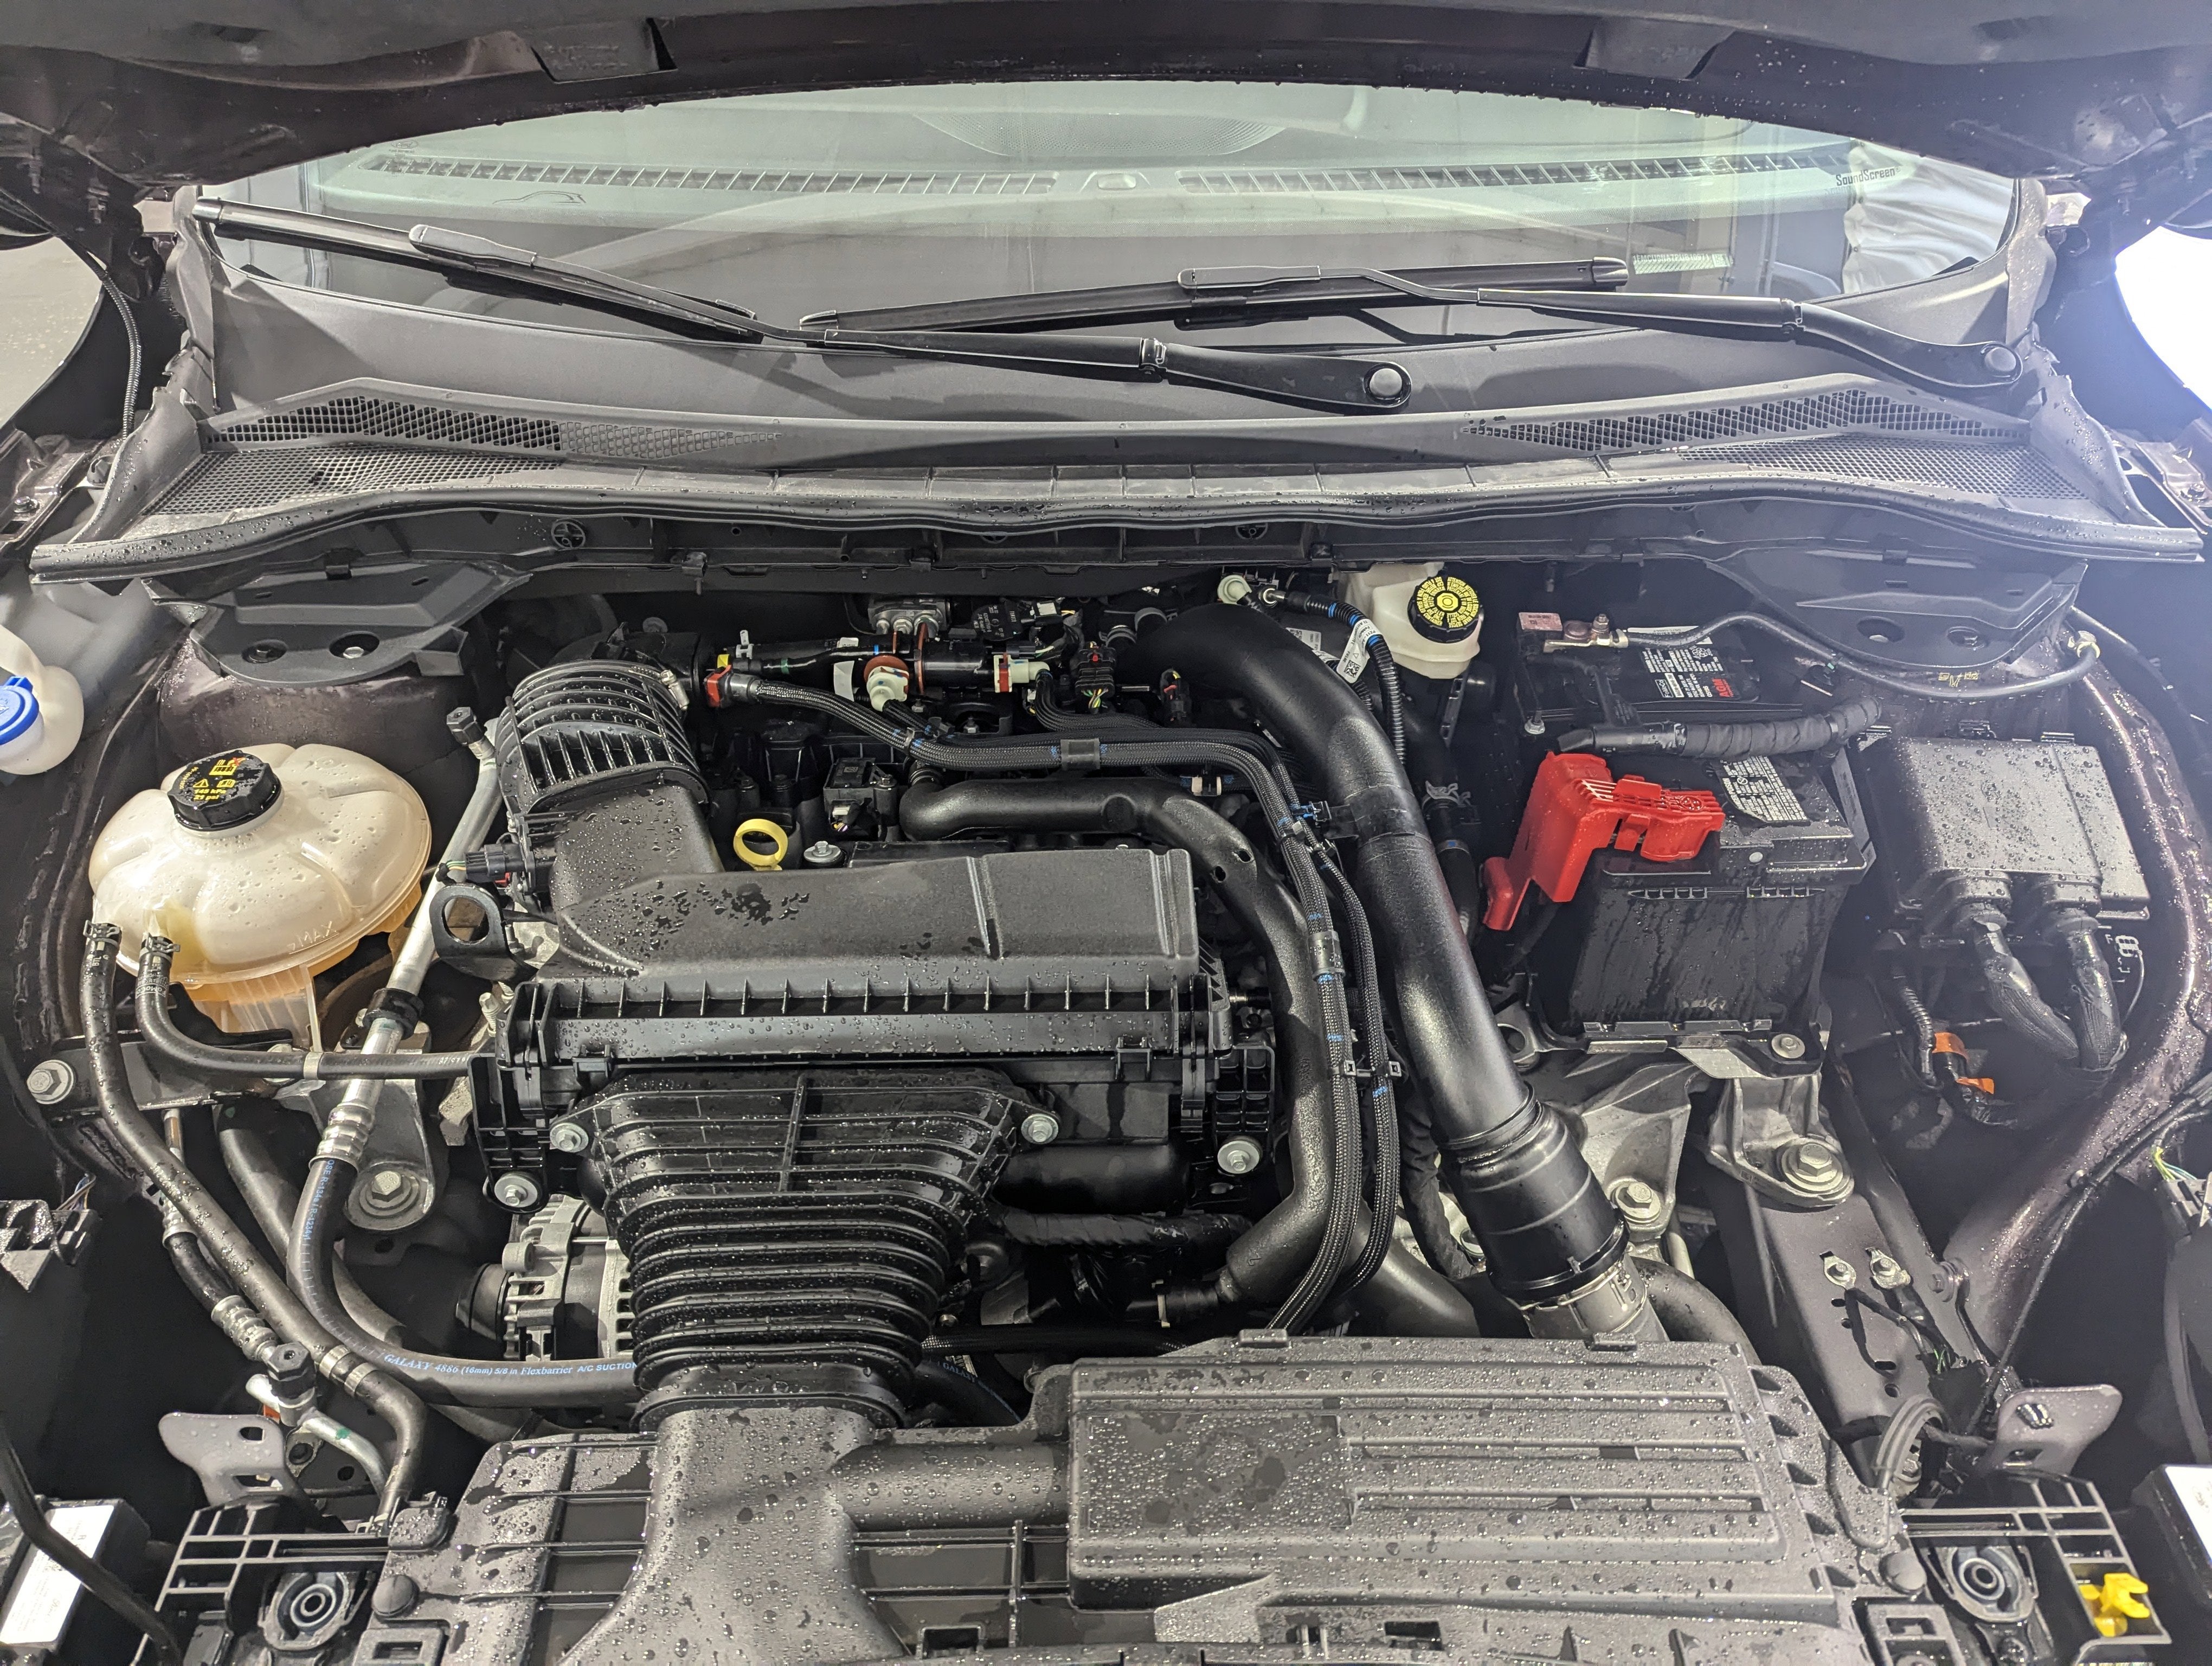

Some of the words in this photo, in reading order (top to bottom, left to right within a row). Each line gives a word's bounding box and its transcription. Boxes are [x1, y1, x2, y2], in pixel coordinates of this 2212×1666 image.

[1712, 678, 1729, 696] AGM
[297, 921, 337, 947] MAX
[323, 1159, 335, 1175] OSE
[384, 1354, 432, 1370] GALAXY
[434, 1362, 458, 1375] 4886
[460, 1366, 492, 1376] (16mm)
[520, 1366, 573, 1376] Flexbarrier
[577, 1364, 594, 1373] A/C
